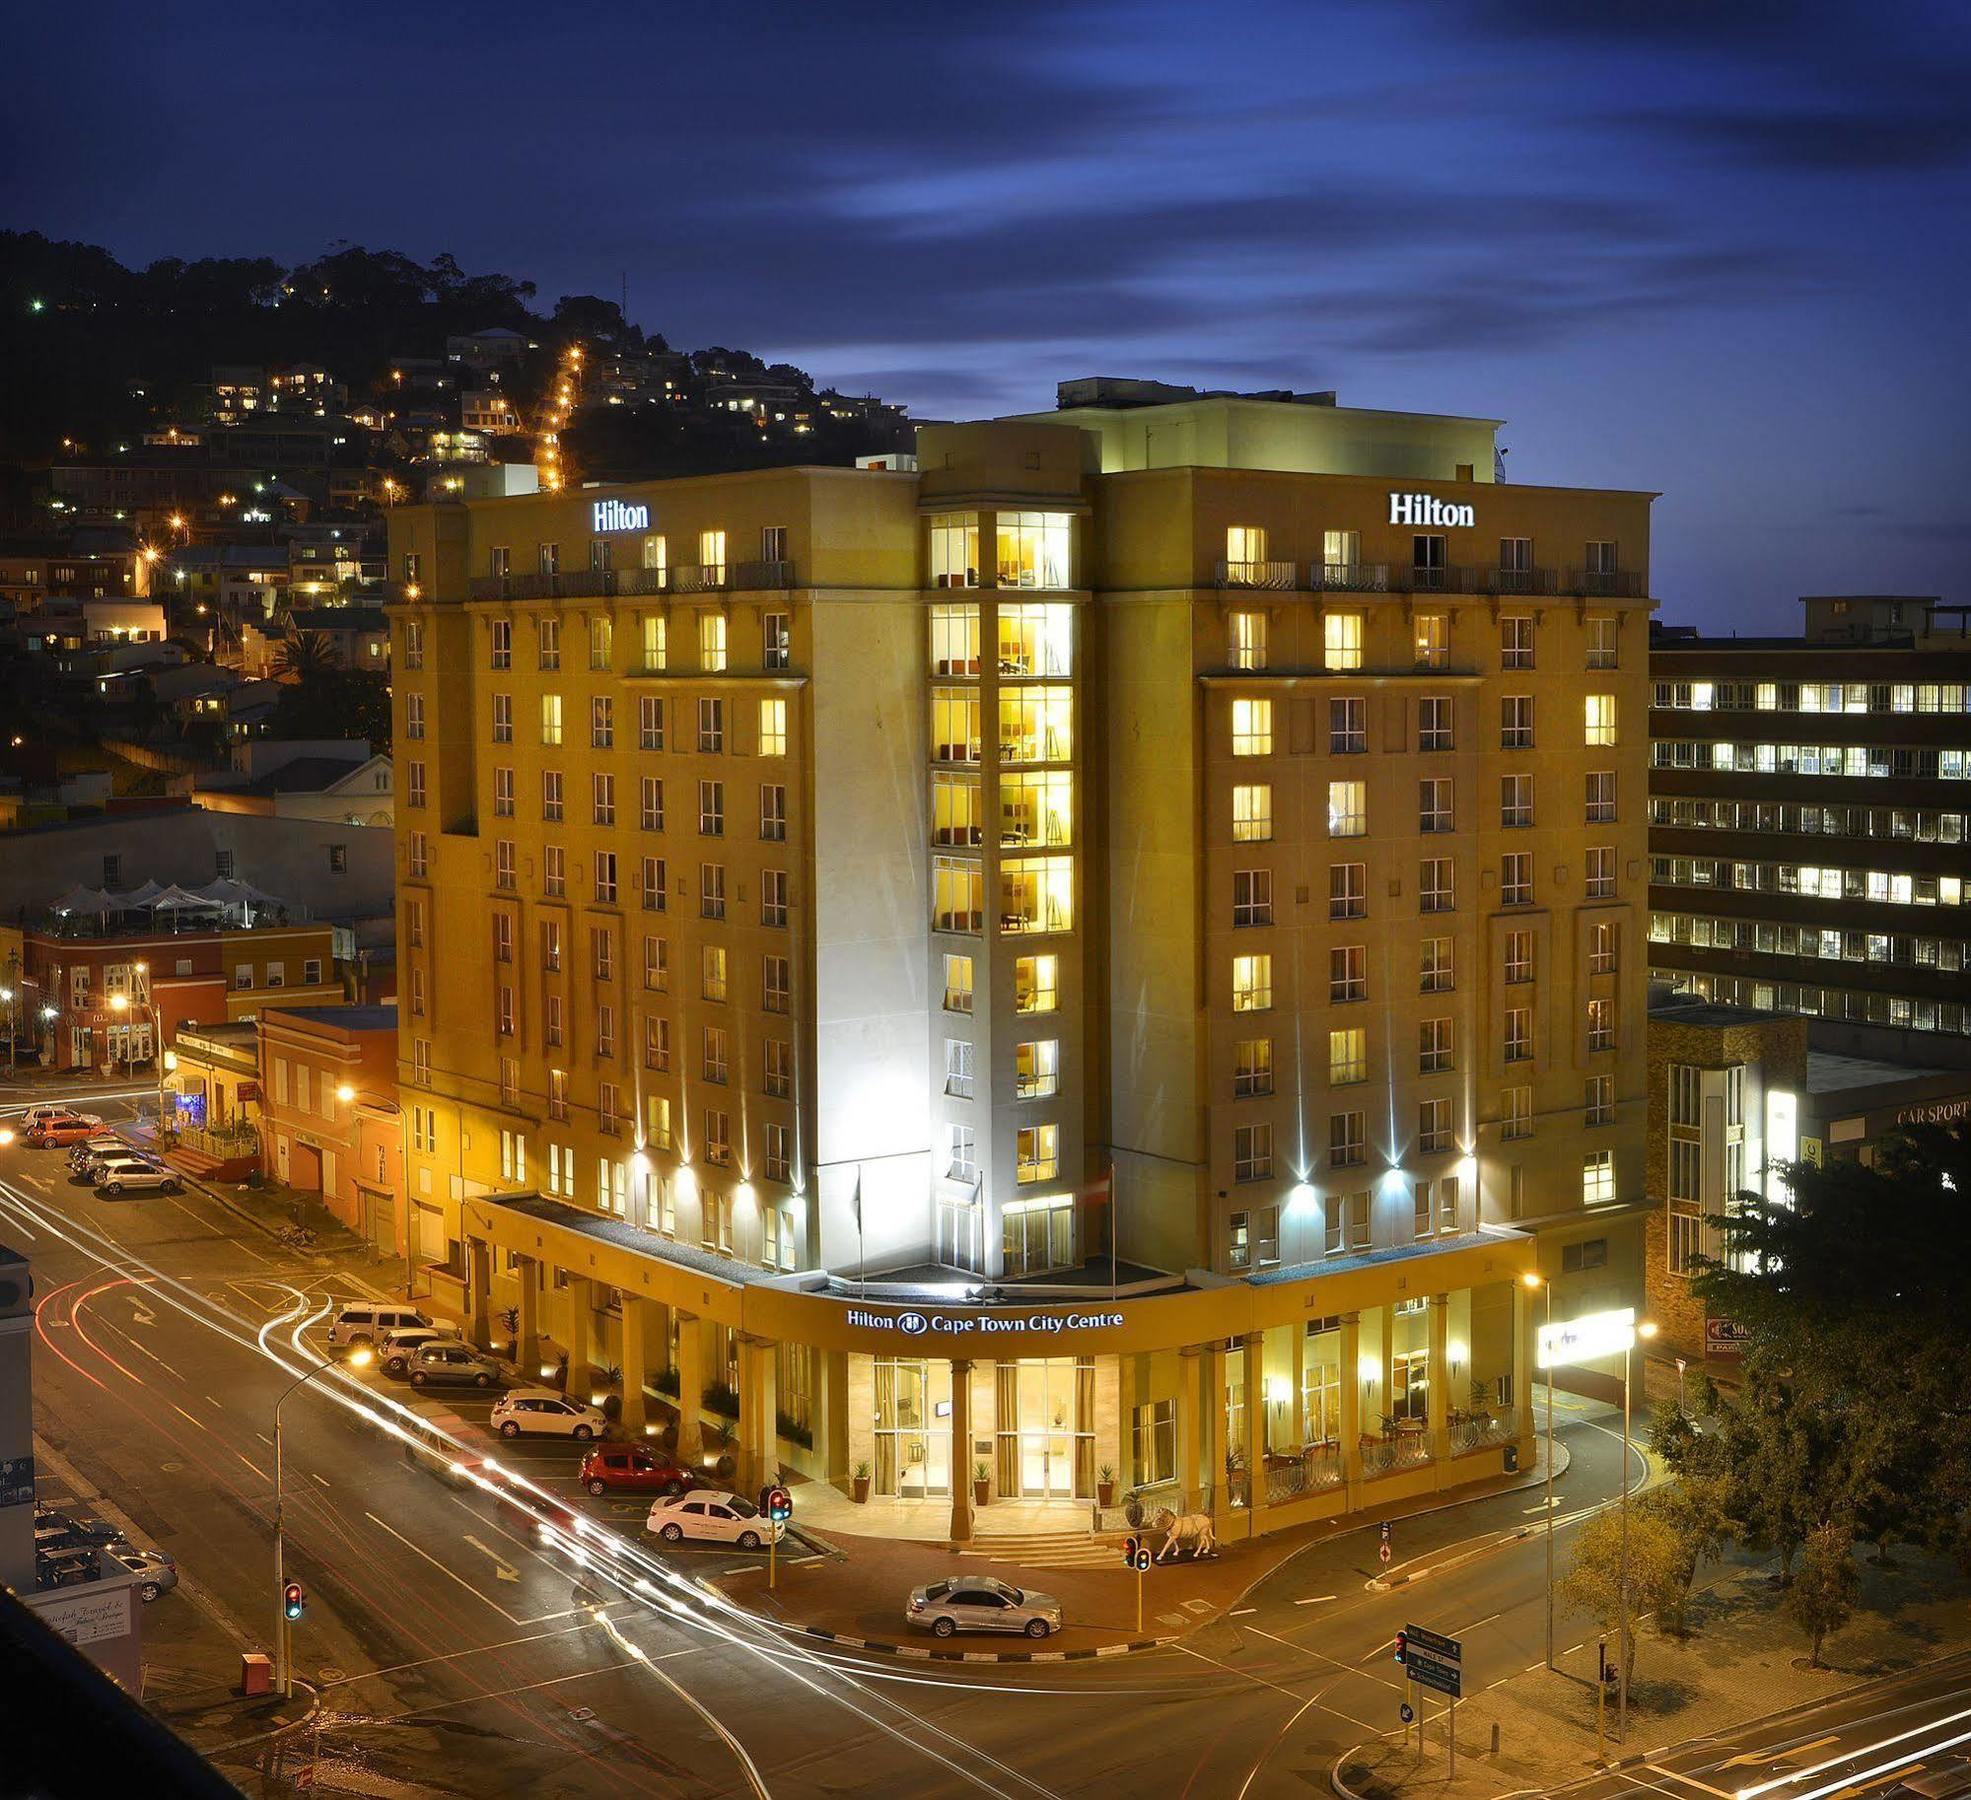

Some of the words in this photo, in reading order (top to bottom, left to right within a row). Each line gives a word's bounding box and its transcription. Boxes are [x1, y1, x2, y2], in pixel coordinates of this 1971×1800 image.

[593, 500, 649, 532] Hilton
[1389, 493, 1475, 527] Hilton
[1897, 1107, 1925, 1125] CAR
[1928, 1100, 1970, 1123] SPORT
[847, 1309, 895, 1330] Hilton
[931, 1315, 975, 1335] Cape
[977, 1316, 1026, 1332] Town
[1028, 1315, 1064, 1334] City
[1066, 1312, 1124, 1329] Centre
